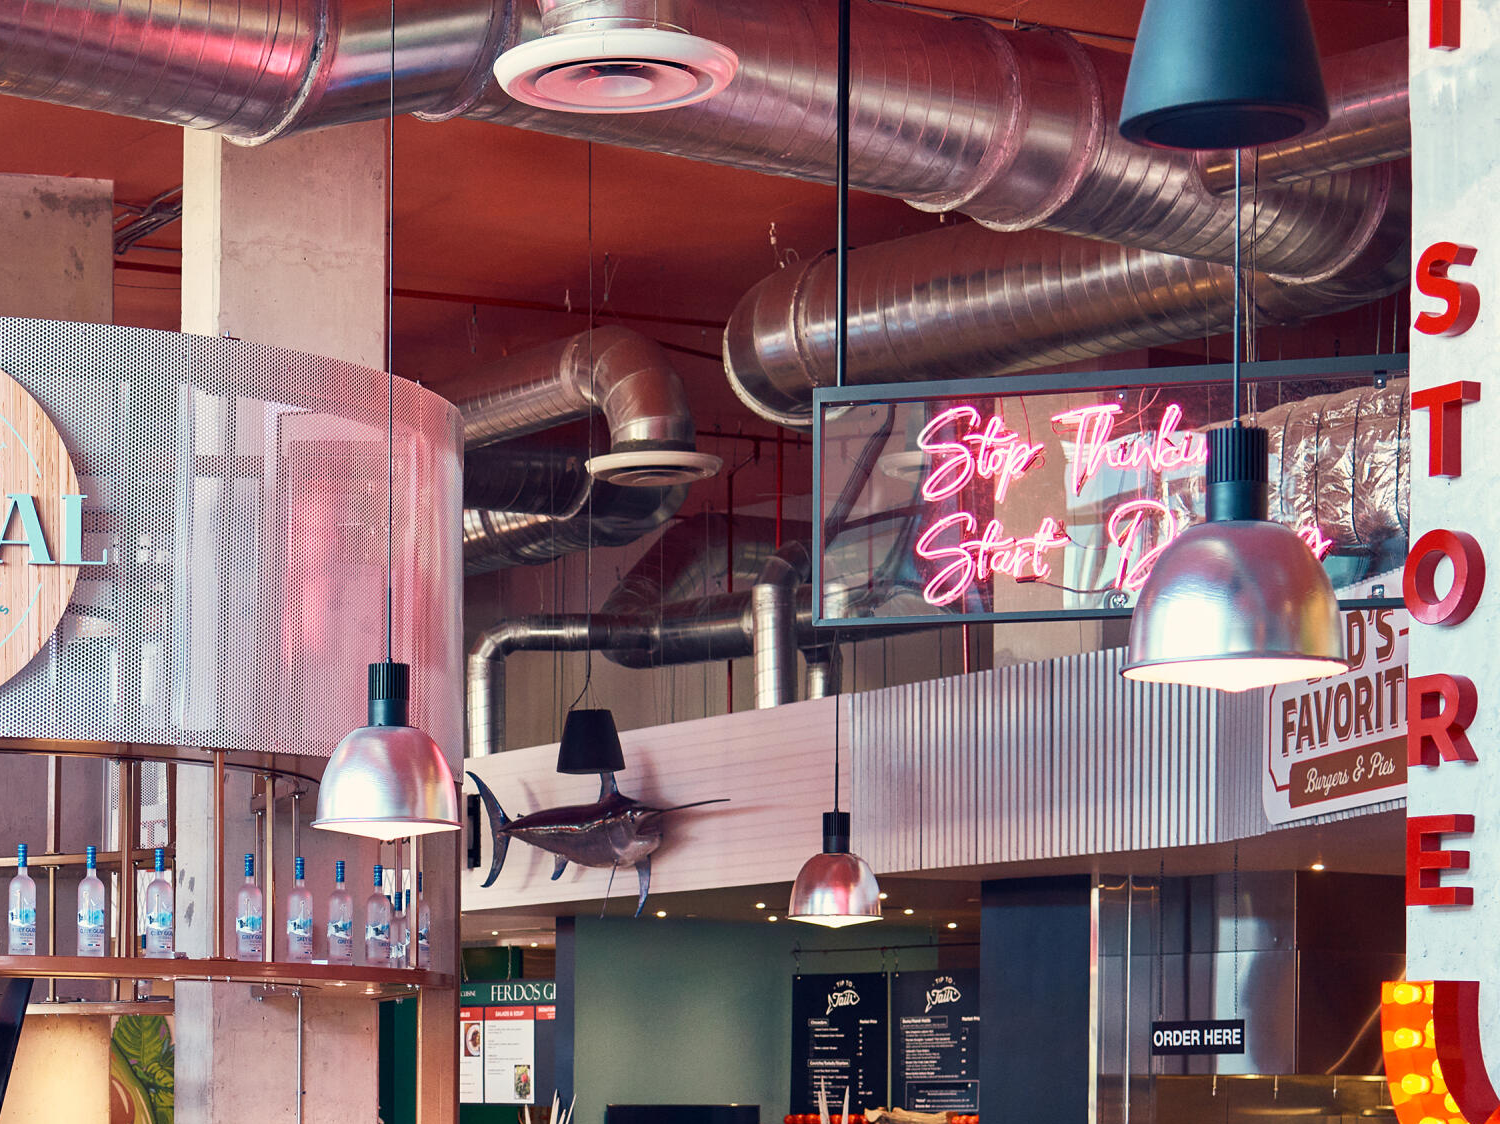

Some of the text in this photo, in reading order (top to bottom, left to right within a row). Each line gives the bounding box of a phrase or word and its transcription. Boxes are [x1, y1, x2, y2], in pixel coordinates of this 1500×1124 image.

[916, 403, 1208, 503] Stop Thinki
[915, 511, 1072, 607] Start
[1402, 241, 1486, 907] STORE
[1281, 664, 1408, 758] FAVORIT
[1304, 751, 1396, 796] Burgers & Pies
[491, 982, 557, 1002] FERDOS G
[1153, 1028, 1242, 1047] ORDER HERE
